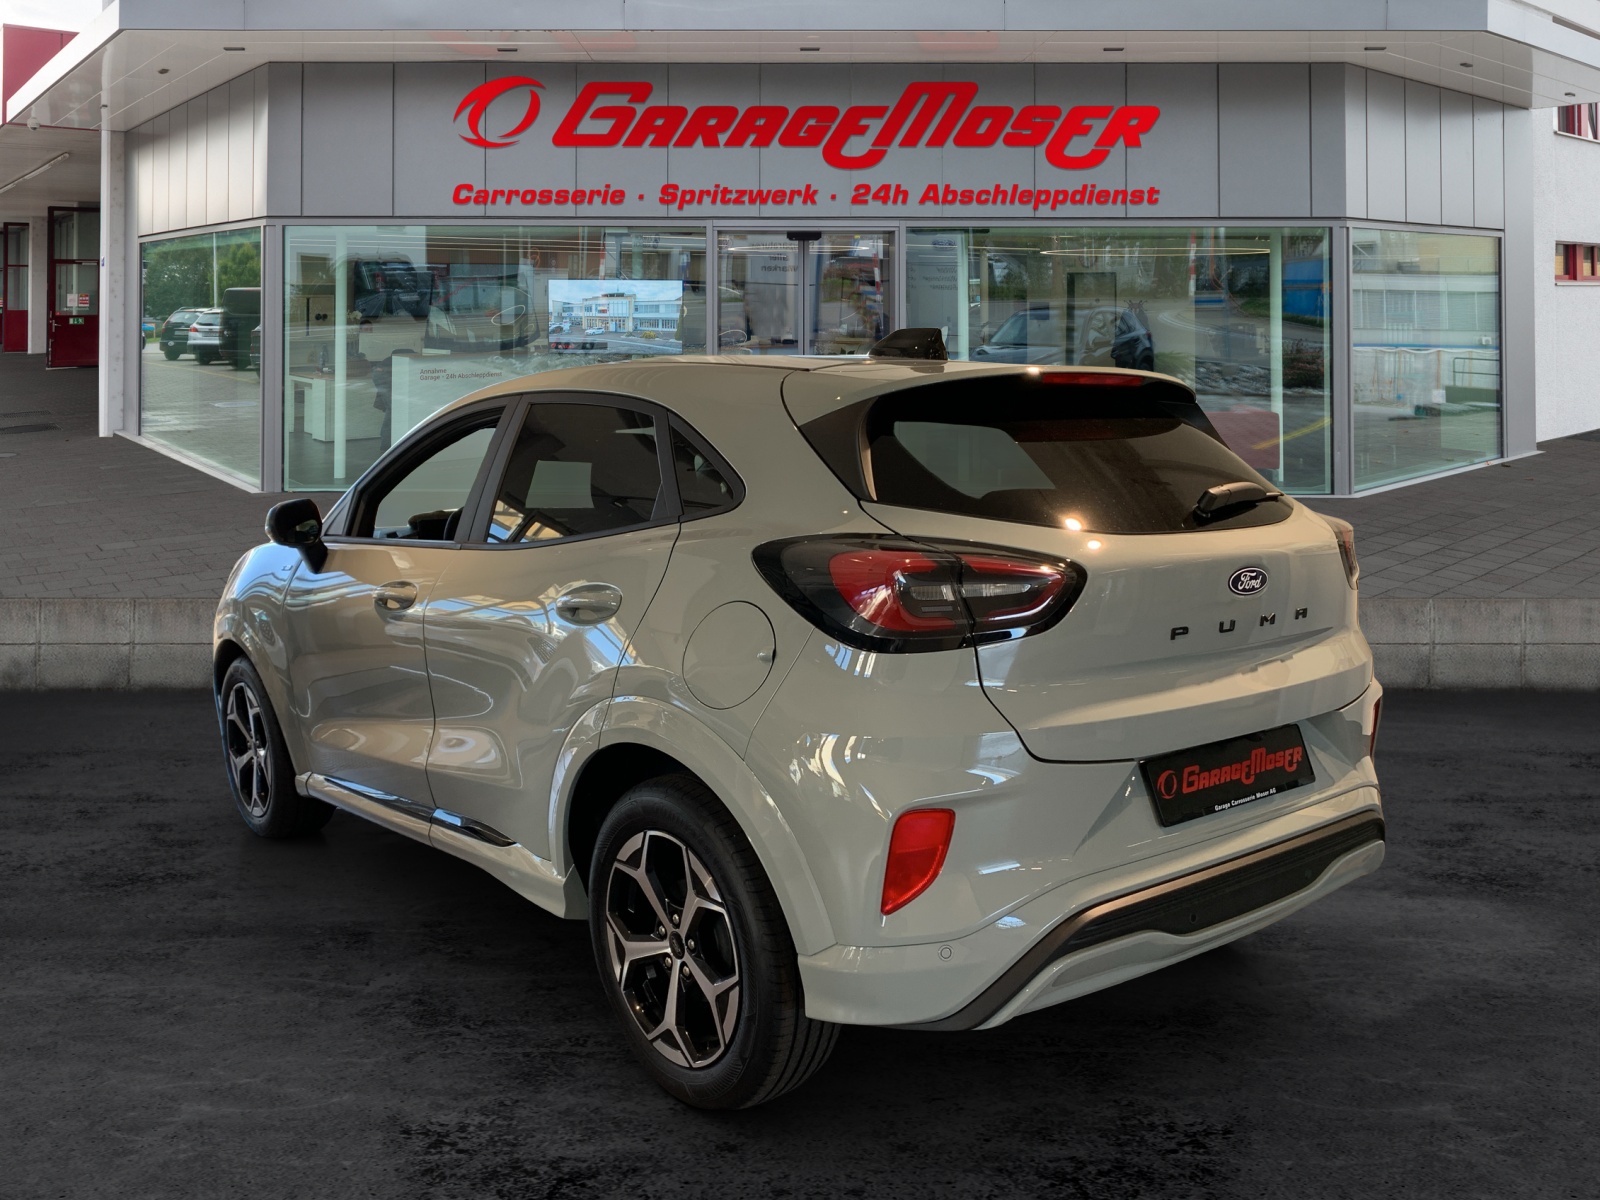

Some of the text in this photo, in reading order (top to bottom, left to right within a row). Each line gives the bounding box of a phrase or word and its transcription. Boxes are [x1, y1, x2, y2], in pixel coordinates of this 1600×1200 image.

[452, 183, 626, 205] Carrosserie
[658, 183, 819, 211] Spritzwerk
[850, 183, 909, 205] 24h
[918, 183, 1161, 211] Abschleppdienst
[458, 371, 503, 379] Abschleppdienst
[1237, 571, 1263, 591] Ford
[1170, 607, 1308, 641] PUMA
[1214, 802, 1230, 811] Garage
[1231, 795, 1255, 805] Carrosserie
[1256, 790, 1269, 798] Moser
